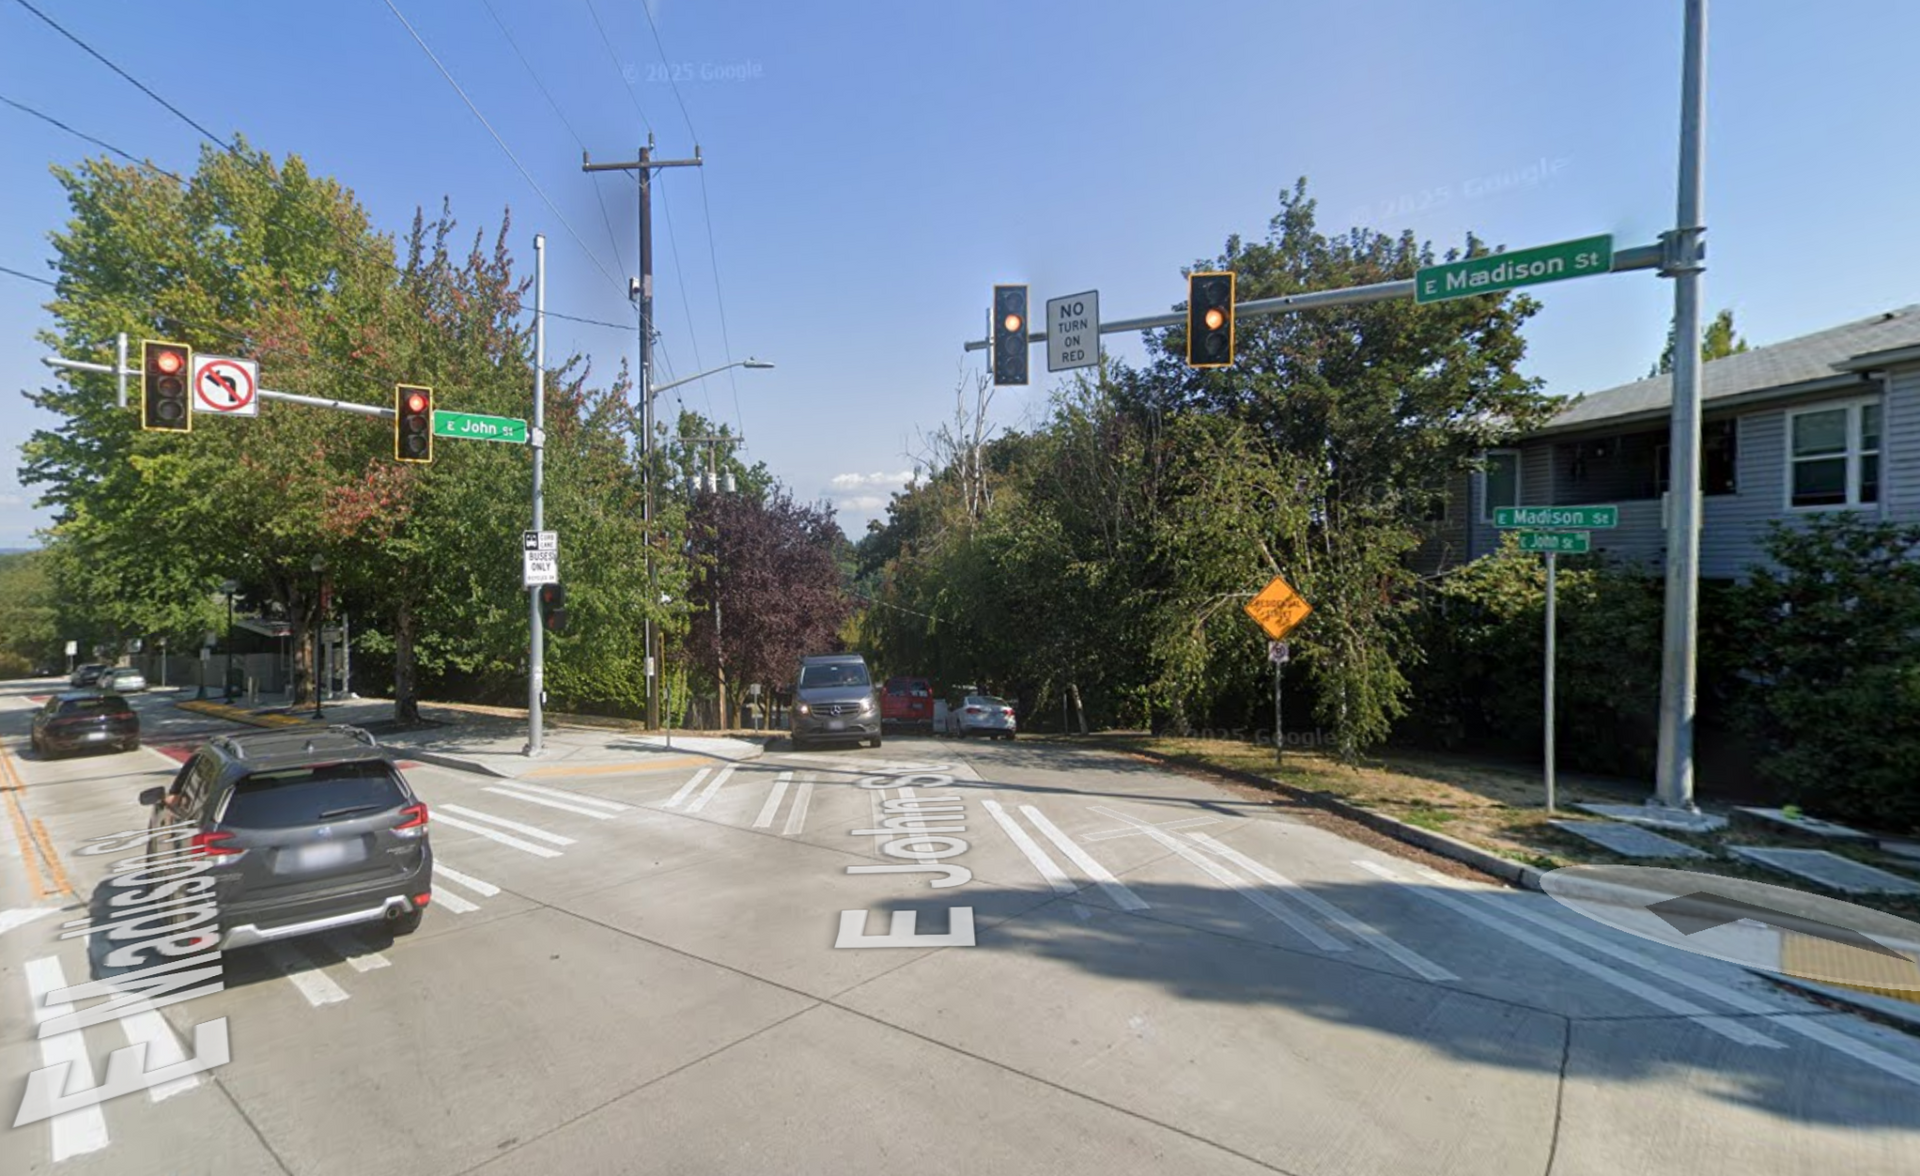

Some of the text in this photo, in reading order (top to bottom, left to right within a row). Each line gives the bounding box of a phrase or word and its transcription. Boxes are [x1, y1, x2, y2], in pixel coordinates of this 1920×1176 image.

[1425, 280, 1437, 295] E
[1575, 252, 1599, 270] St
[1060, 302, 1084, 318] NO
[1058, 318, 1088, 334] TURN
[1064, 335, 1080, 348] ON
[1062, 349, 1085, 363] RED
[447, 419, 513, 436] E John St
[1498, 508, 1609, 525] E Madison St
[1530, 534, 1559, 549] John
[1561, 538, 1573, 549] St
[529, 551, 556, 562] BUSES
[531, 562, 551, 572] ONLY
